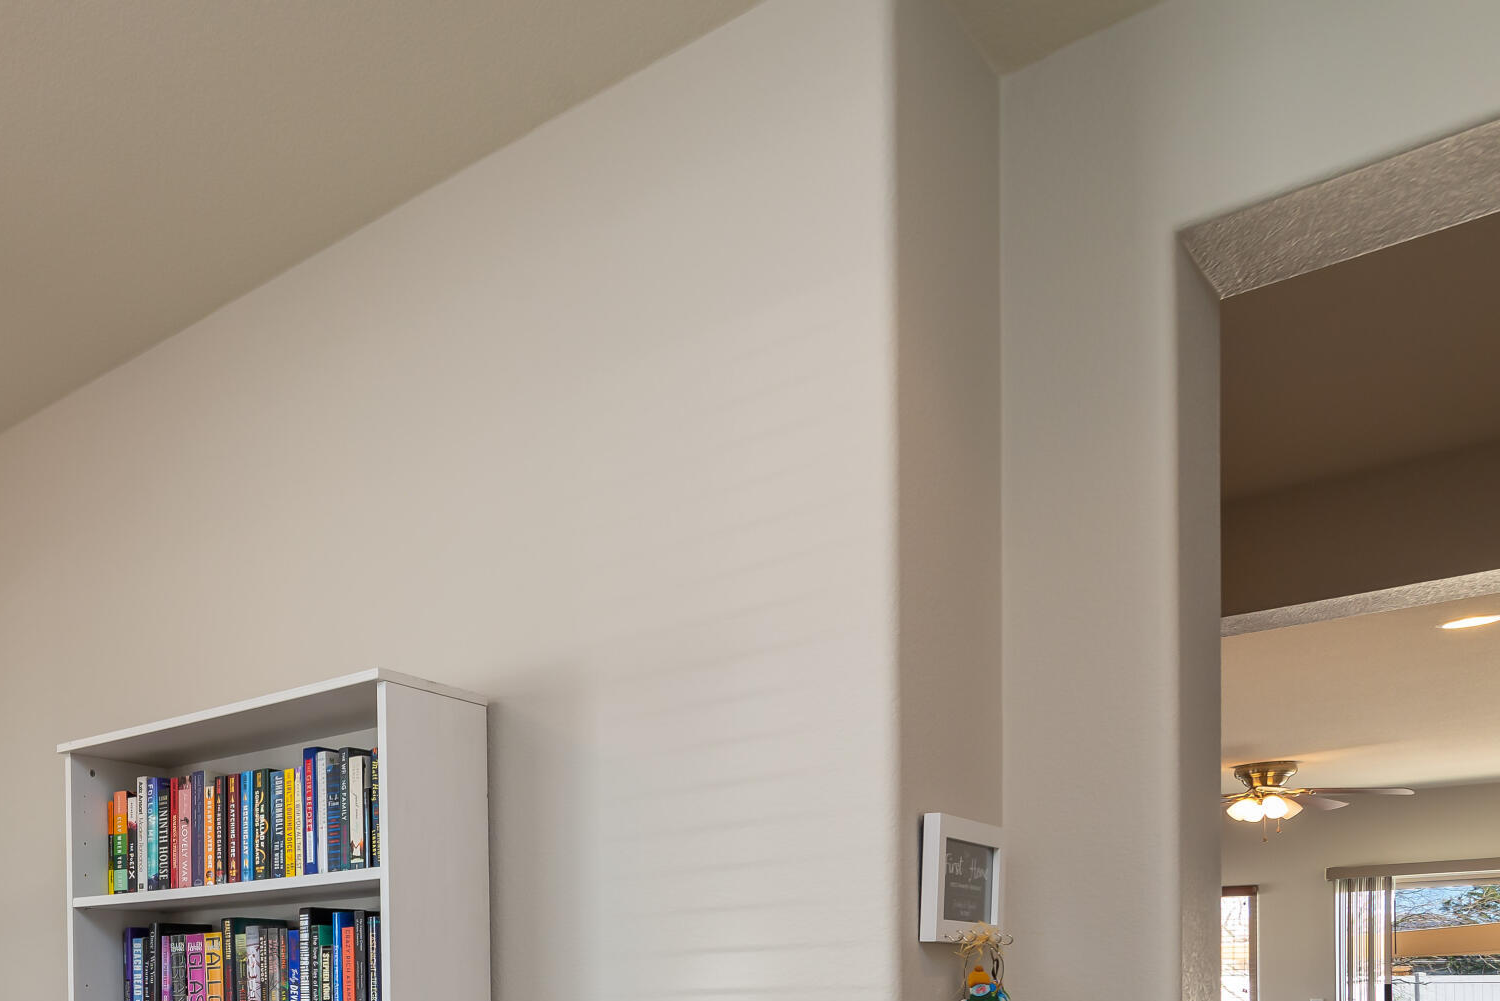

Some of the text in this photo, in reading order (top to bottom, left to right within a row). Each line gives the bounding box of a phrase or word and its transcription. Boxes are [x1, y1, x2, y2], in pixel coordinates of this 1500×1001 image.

[275, 776, 283, 835] JOHN CONNOLLY
[159, 809, 168, 880] NINTH HOUSE
[129, 870, 135, 879] X
[133, 943, 142, 995] BEACH READ
[290, 968, 298, 983] Truly
